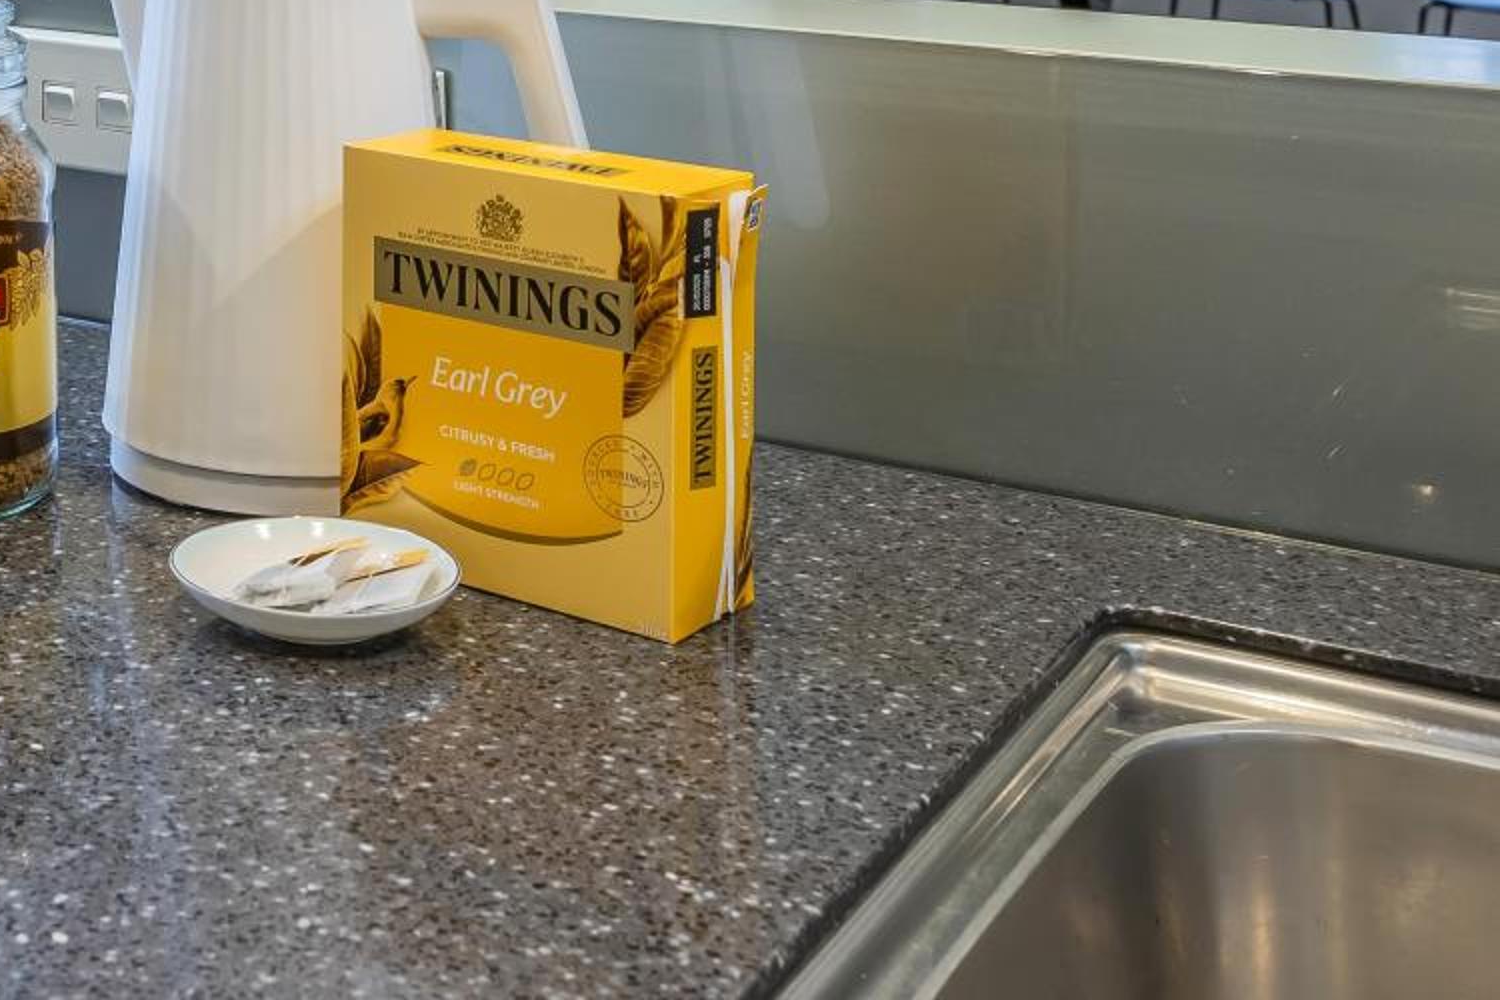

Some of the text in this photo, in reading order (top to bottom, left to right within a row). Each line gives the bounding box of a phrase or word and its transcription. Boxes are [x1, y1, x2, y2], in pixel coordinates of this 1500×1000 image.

[384, 251, 621, 336] TWININGS
[431, 355, 568, 419] Earl Grey
[695, 353, 713, 484] TWININGS
[438, 424, 556, 464] CITRUSY & FRESH
